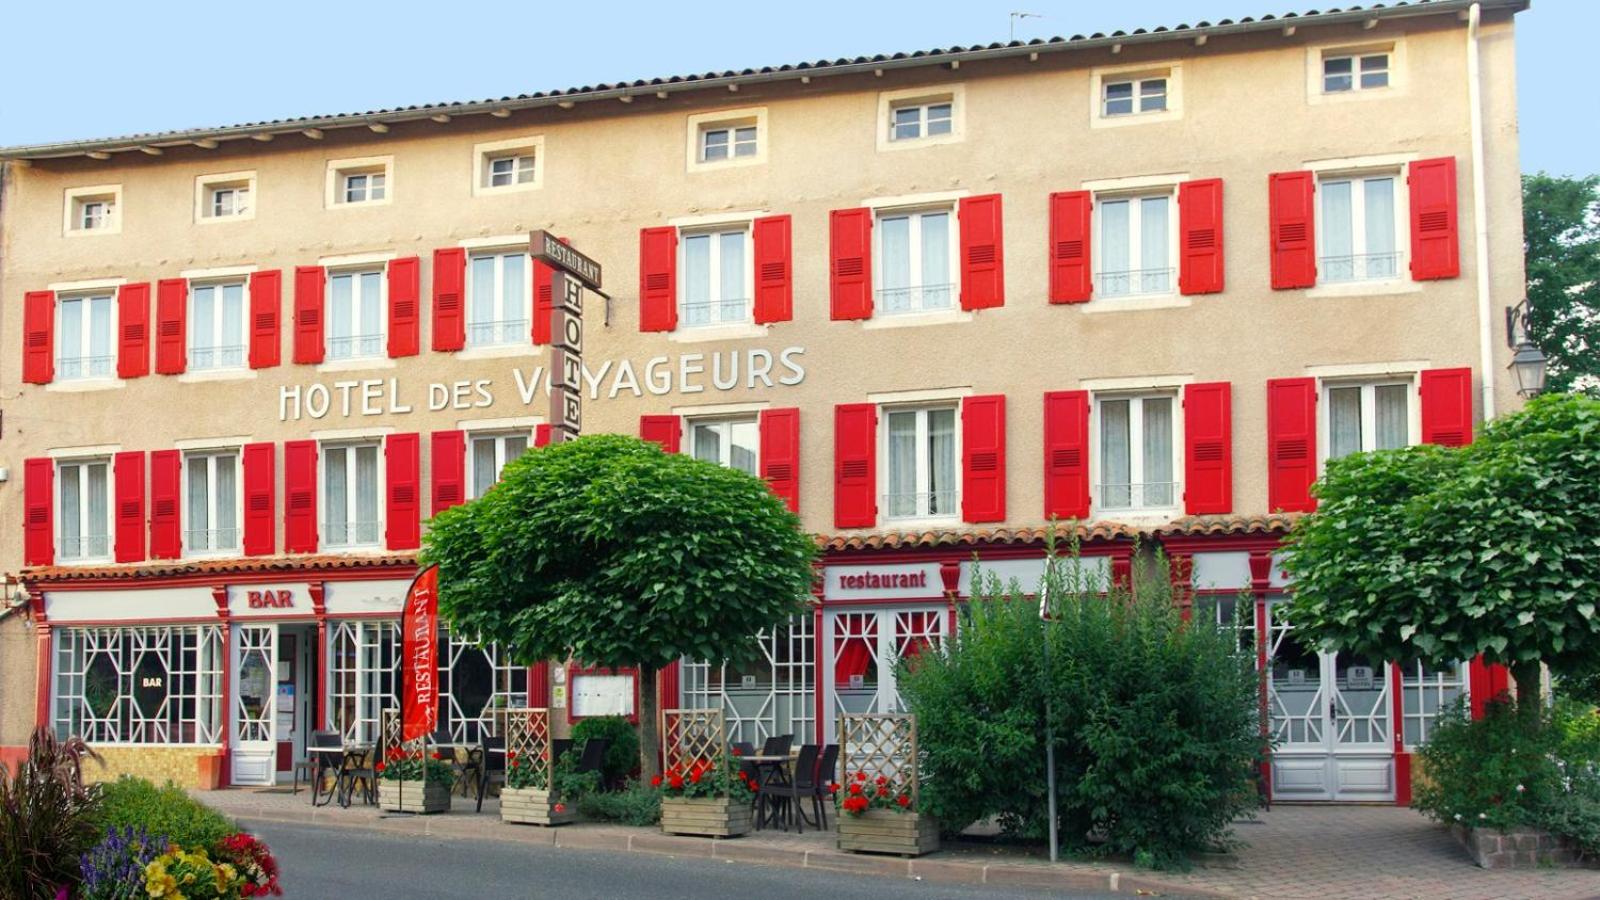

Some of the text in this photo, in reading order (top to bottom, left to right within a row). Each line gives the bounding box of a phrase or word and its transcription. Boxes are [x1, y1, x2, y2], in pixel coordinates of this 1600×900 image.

[545, 236, 599, 283] RESTAURANT
[564, 277, 581, 441] HOTE
[279, 346, 806, 421] HOTEL DES VYAGEURS
[247, 590, 294, 609] BAR
[839, 569, 927, 590] restaurant
[413, 588, 432, 705] RESTAURANT
[142, 677, 162, 688] BAR
